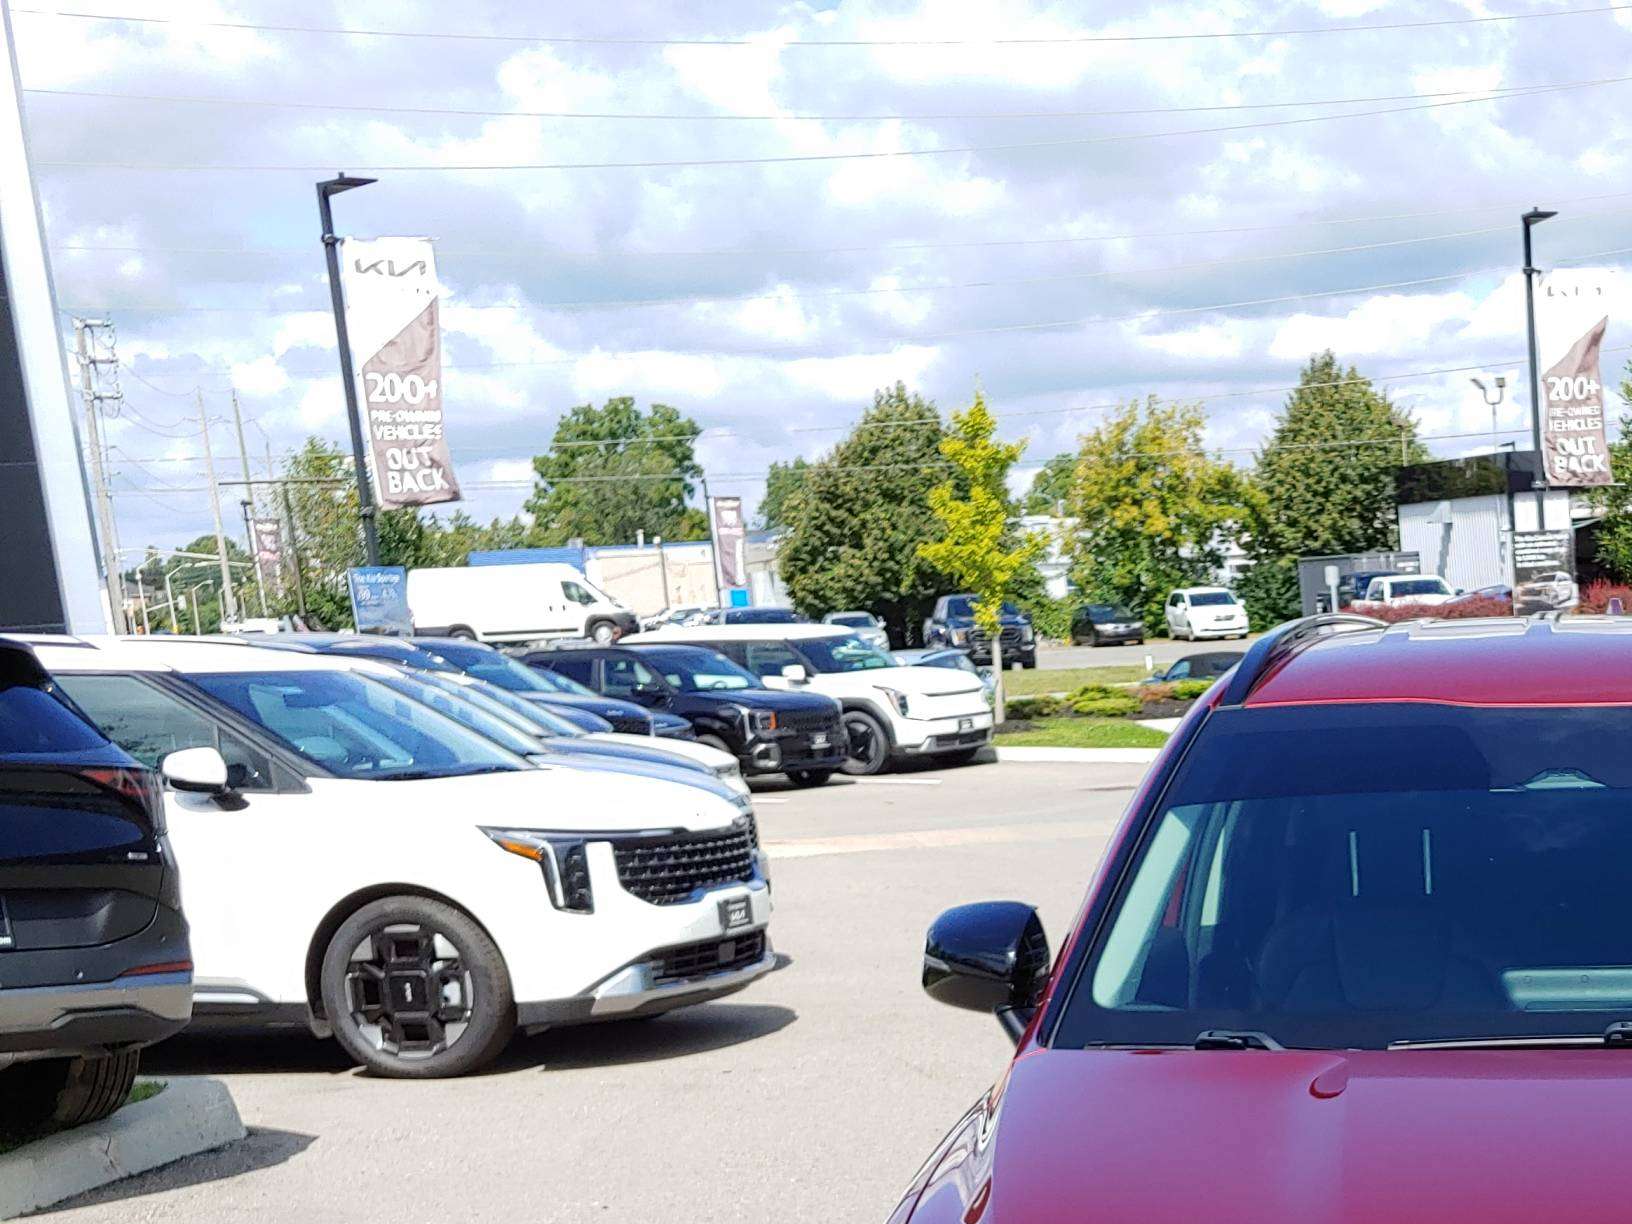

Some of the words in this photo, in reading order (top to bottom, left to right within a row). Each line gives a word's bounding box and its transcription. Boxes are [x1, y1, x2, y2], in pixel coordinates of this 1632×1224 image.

[1547, 376, 1601, 401] 200+
[373, 423, 442, 441] VEHICLES
[1556, 436, 1596, 456] OUT
[386, 446, 433, 471] OUT
[1554, 454, 1608, 474] BACK
[387, 467, 450, 494] BACK
